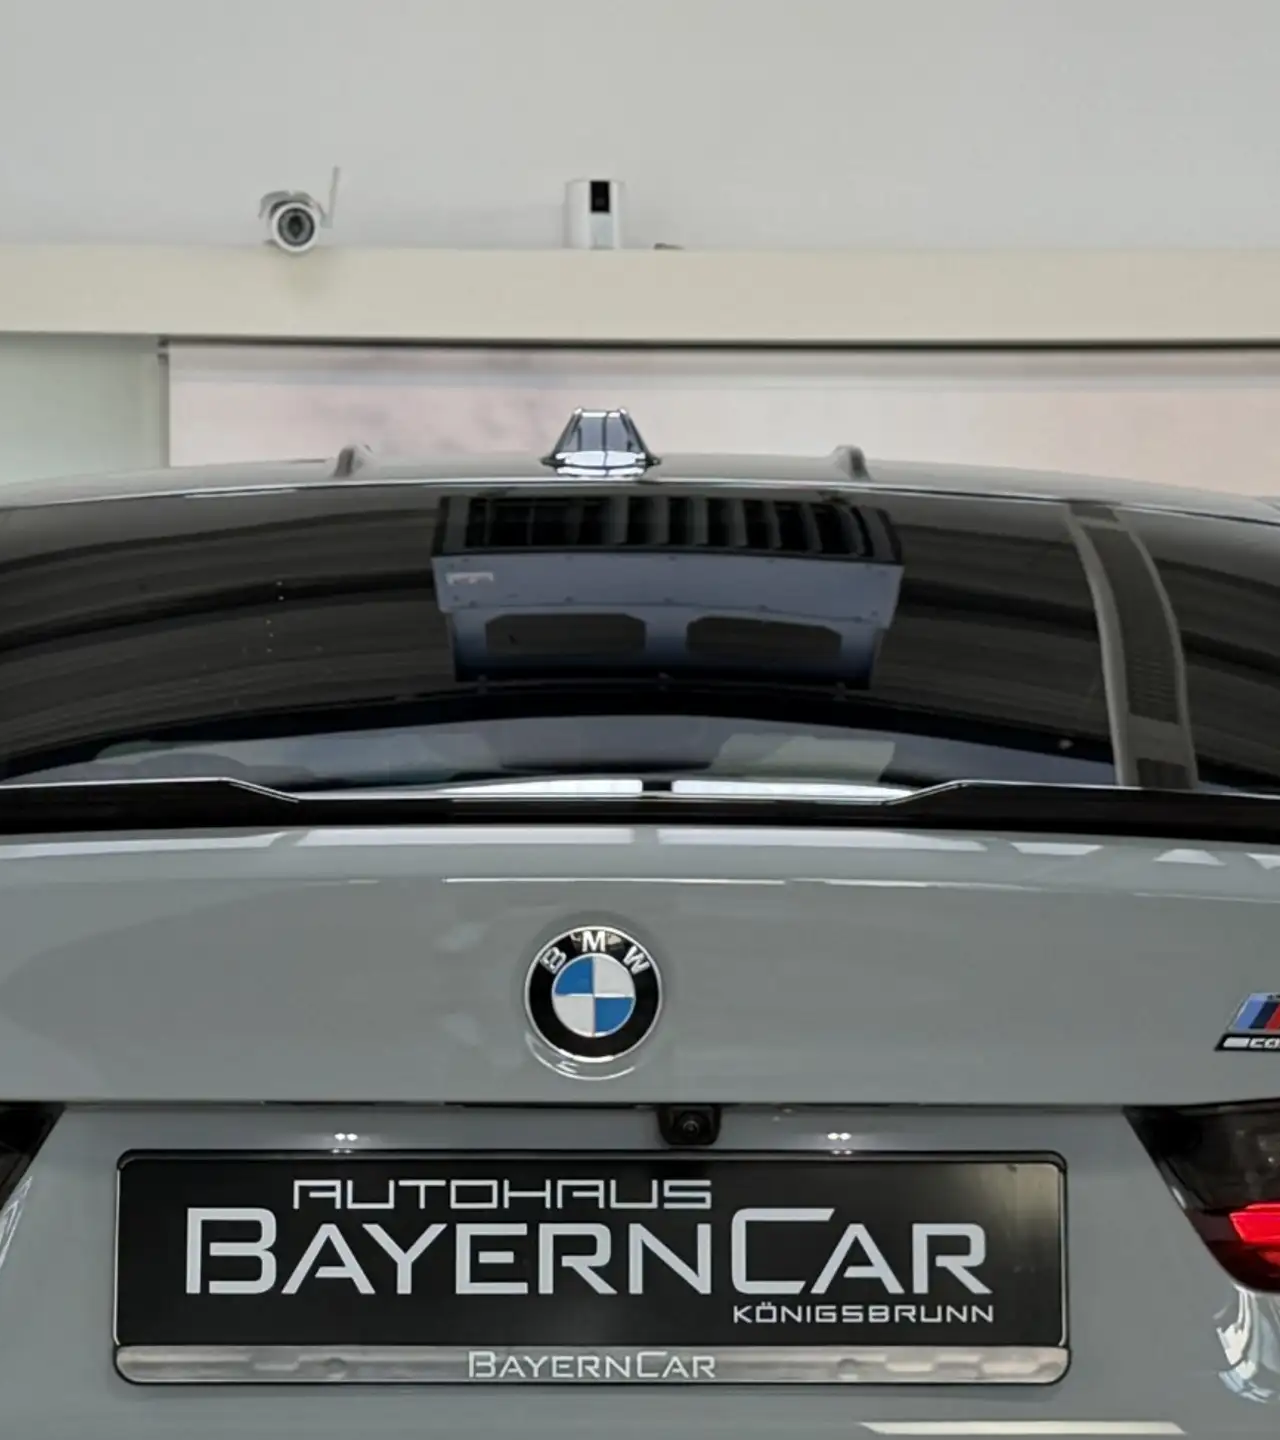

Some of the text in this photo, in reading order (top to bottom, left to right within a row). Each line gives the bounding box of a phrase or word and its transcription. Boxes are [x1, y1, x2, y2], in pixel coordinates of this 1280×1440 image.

[540, 930, 651, 975] BMW
[292, 1178, 713, 1210] AUTOHAUS
[733, 1301, 995, 1324] KÖNIGSBRUNN
